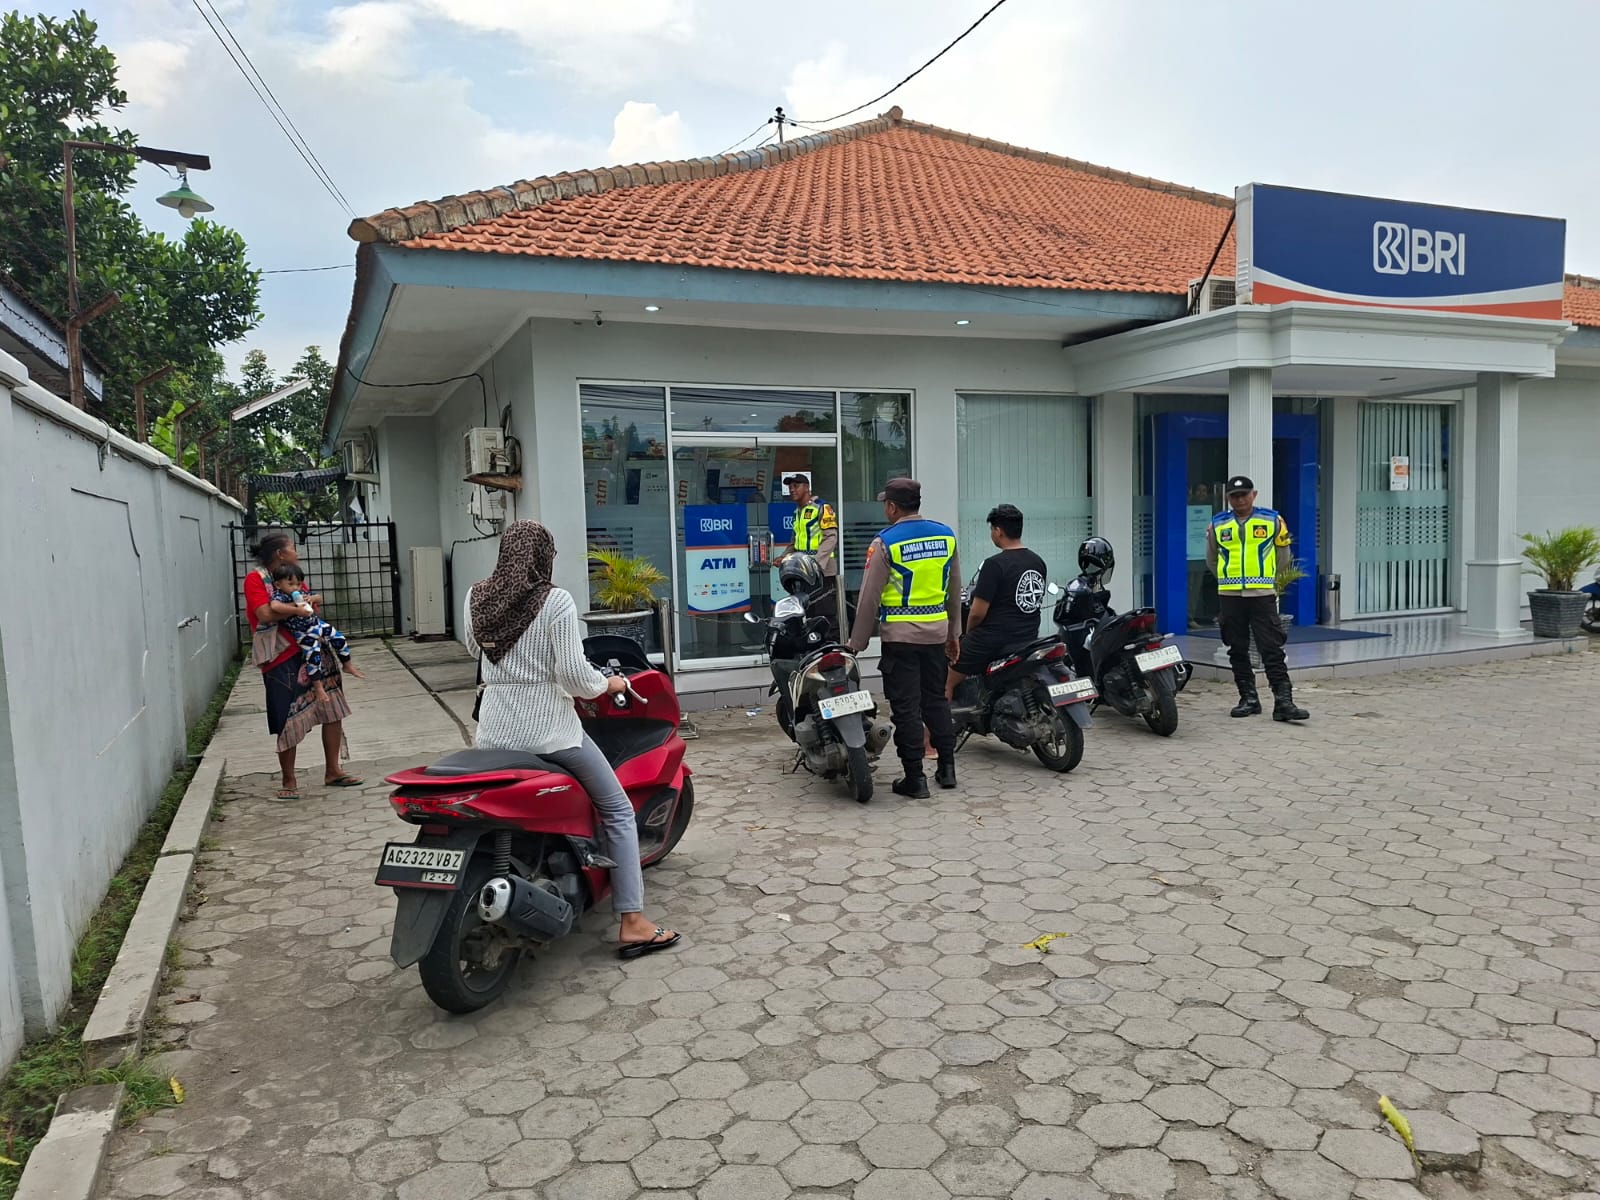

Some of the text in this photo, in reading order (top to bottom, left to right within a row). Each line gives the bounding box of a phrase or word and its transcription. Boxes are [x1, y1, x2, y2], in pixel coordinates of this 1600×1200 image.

[1411, 228, 1465, 276] BRI
[713, 518, 733, 531] BRI
[700, 557, 736, 570] ATM
